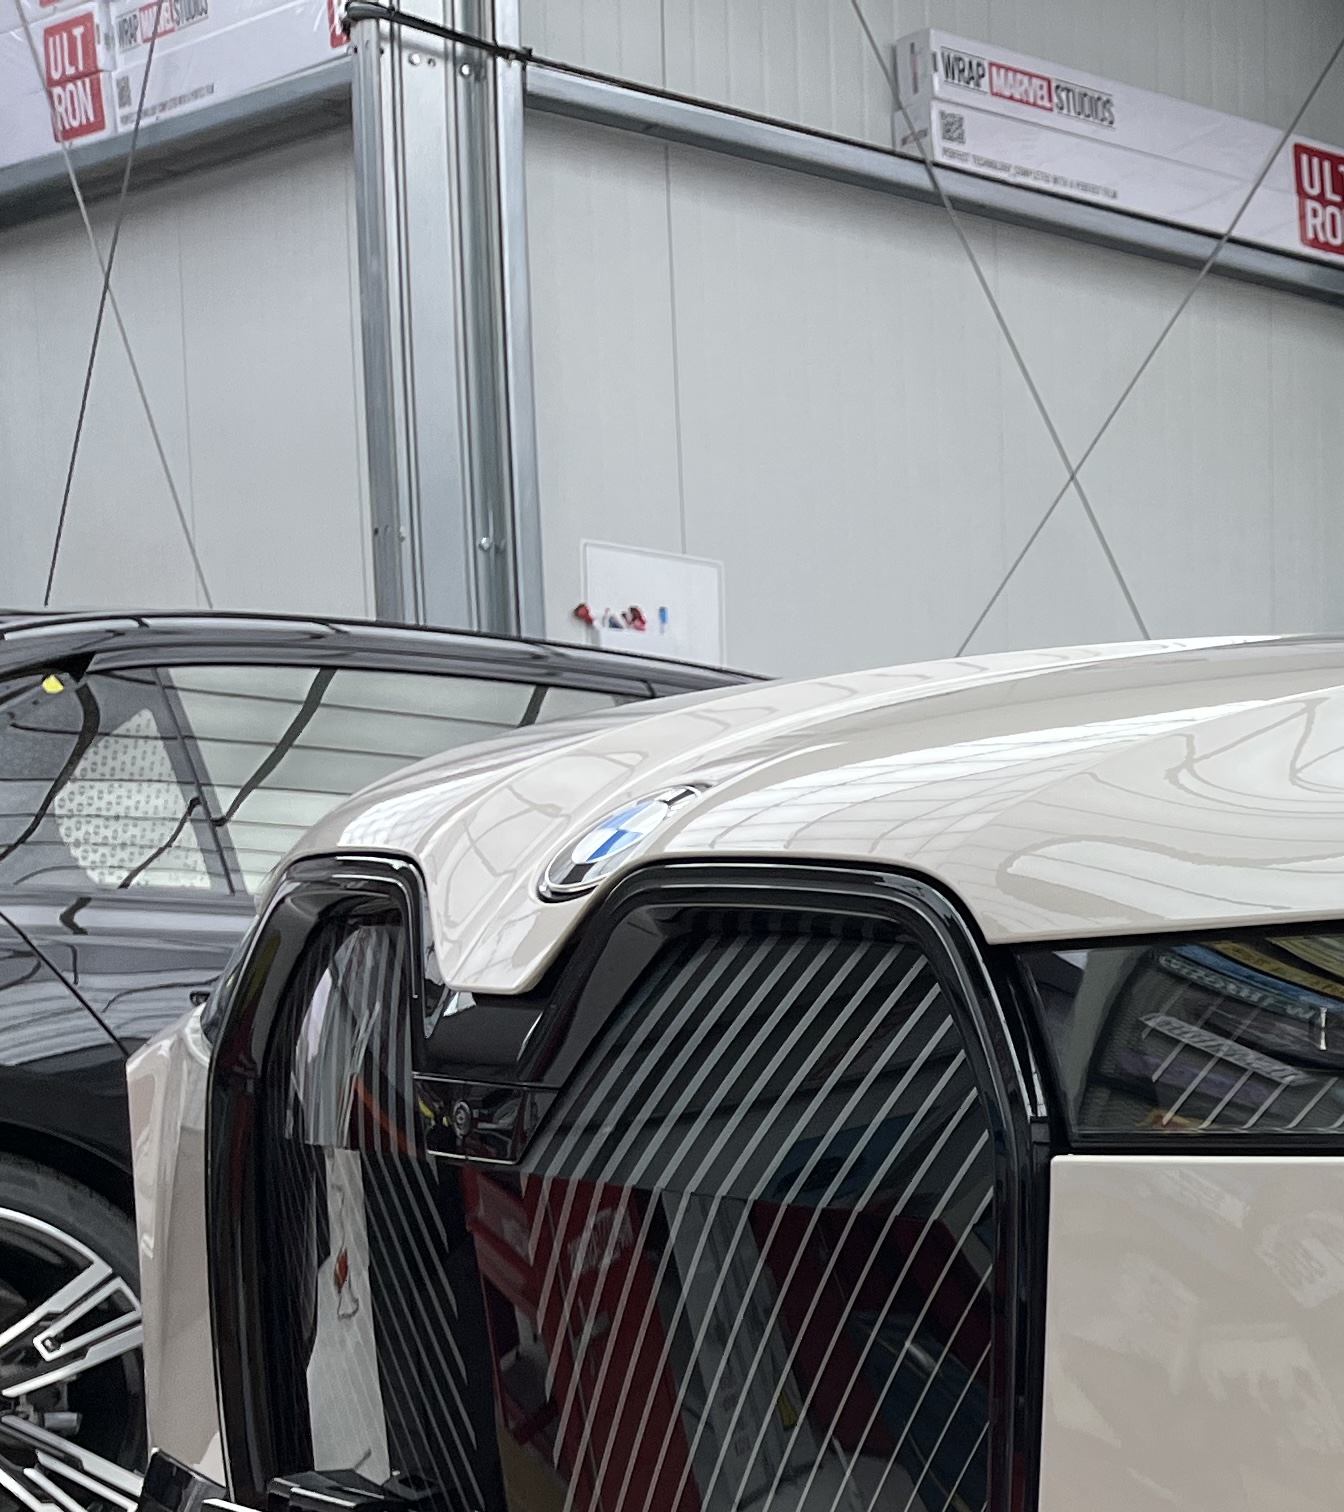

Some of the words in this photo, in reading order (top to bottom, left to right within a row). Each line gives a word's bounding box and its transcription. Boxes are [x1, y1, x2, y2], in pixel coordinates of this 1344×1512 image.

[48, 25, 84, 80] ULT
[53, 77, 94, 131] RON
[940, 50, 986, 88] WRAP
[991, 65, 1052, 107] MARVEL
[1054, 82, 1116, 126] STUDIOS
